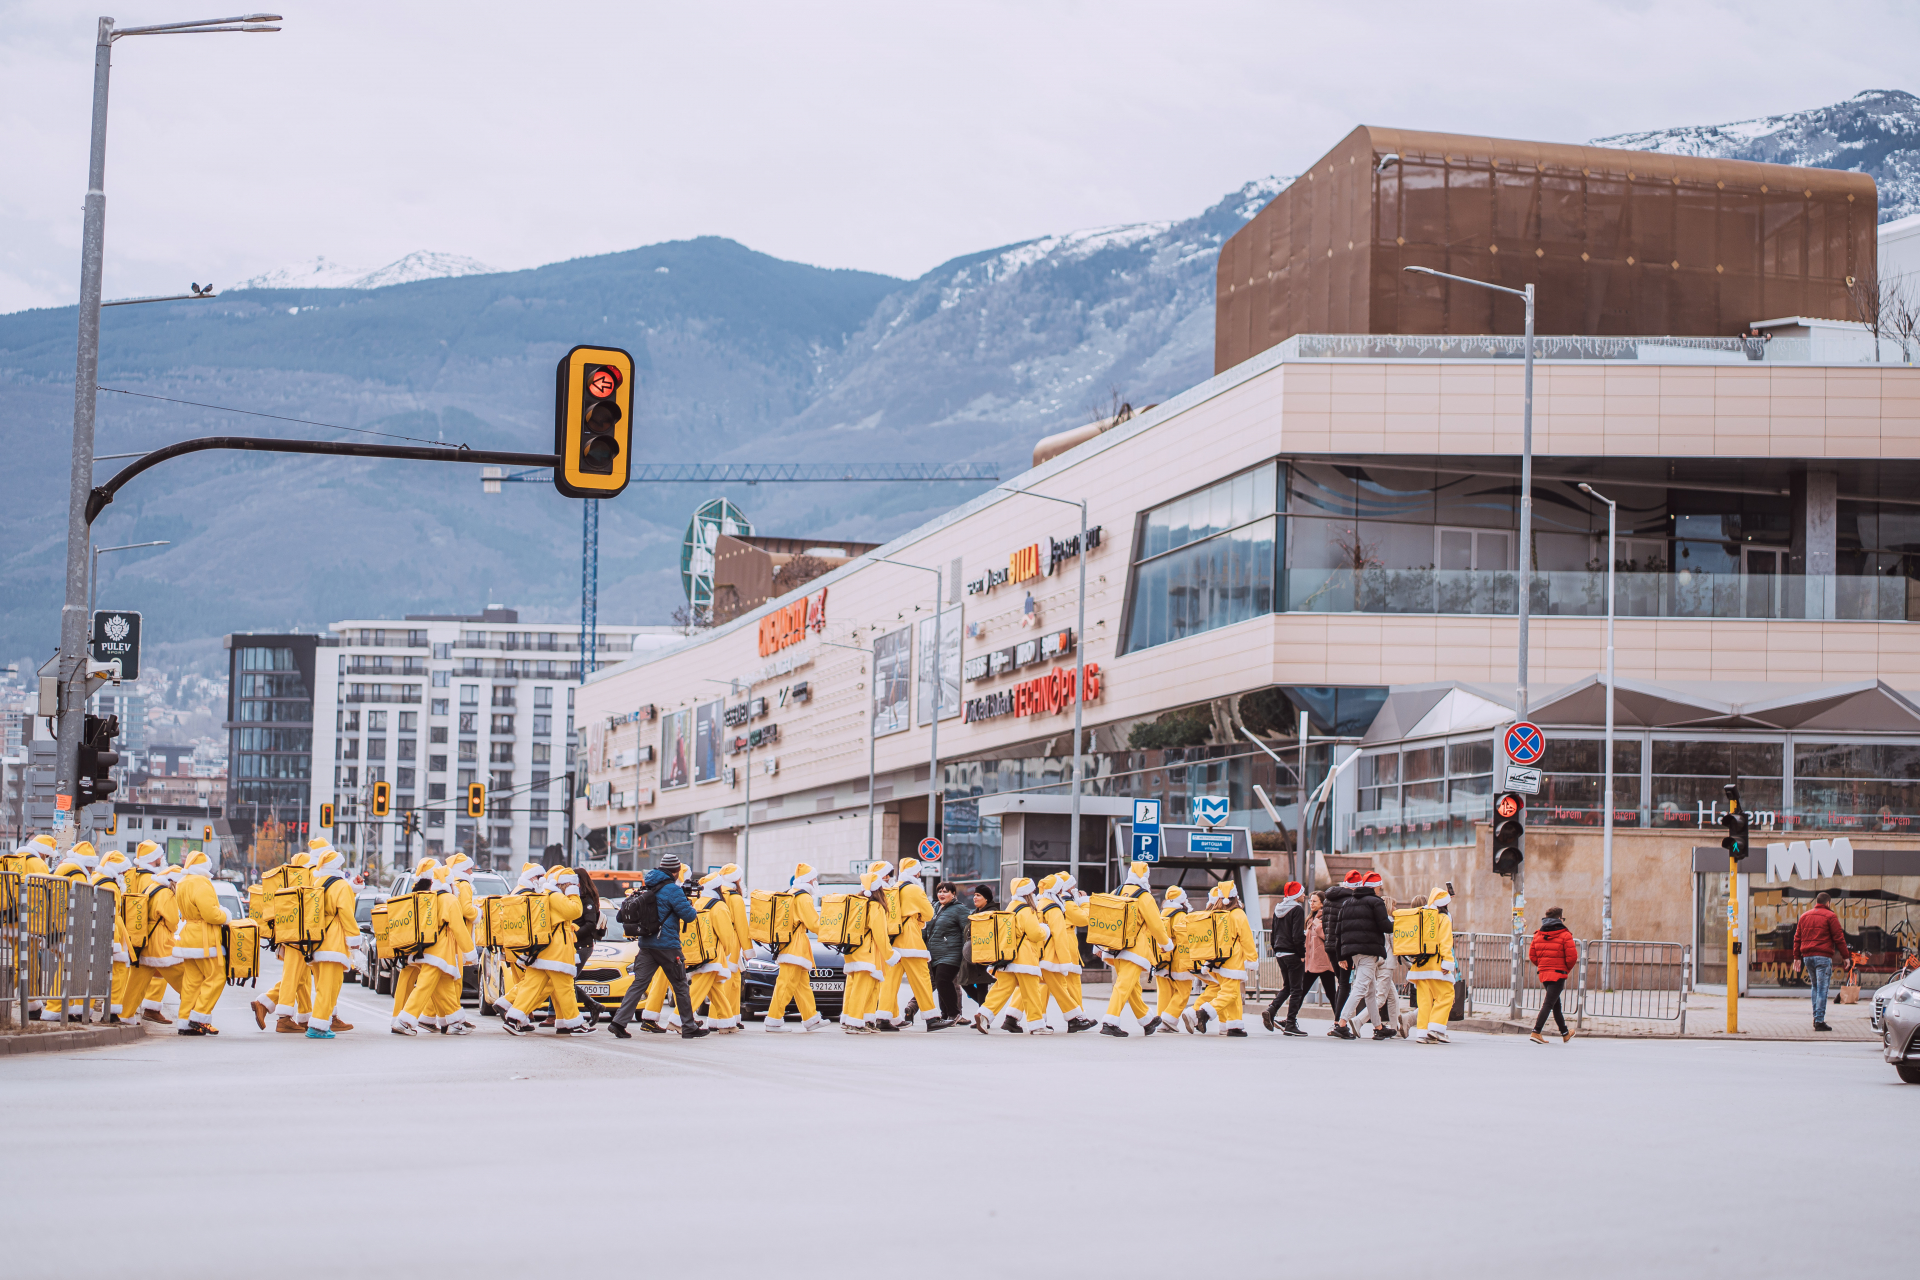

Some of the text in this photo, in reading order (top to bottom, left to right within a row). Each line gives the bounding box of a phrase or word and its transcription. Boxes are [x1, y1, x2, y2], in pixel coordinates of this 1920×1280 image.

[1008, 543, 1039, 585] BILLA
[101, 642, 131, 652] PULEV
[1013, 663, 1099, 718] TECHNOPOIS
[1555, 805, 1581, 819] Harem
[1663, 808, 1691, 821] Harem
[1697, 799, 1775, 826] Haem
[1774, 810, 1801, 825] Harem
[1828, 810, 1855, 825] Harem
[1883, 812, 1910, 826] Harem
[1141, 836, 1152, 850] P
[1767, 837, 1853, 883] MM
[262, 892, 275, 903] Glov
[135, 903, 143, 931] Glovo
[249, 907, 264, 920] Glov
[782, 903, 790, 927] Glovo
[854, 905, 863, 930] Glovo
[1830, 902, 1870, 919] Auto
[275, 914, 295, 925] Glovo
[388, 917, 410, 931] Glovo
[503, 919, 523, 930] Glovo
[750, 912, 766, 925] Glovo
[820, 916, 838, 926] Glovo
[1089, 917, 1117, 932] Glovo
[972, 935, 990, 946] Glovo
[1188, 934, 1209, 944] Glovo
[1394, 929, 1415, 939] Glovo
[236, 932, 245, 959] Glovo
[1178, 945, 1190, 954] Glo
[1761, 962, 1845, 981] MM Ao
[580, 986, 597, 994] 050
